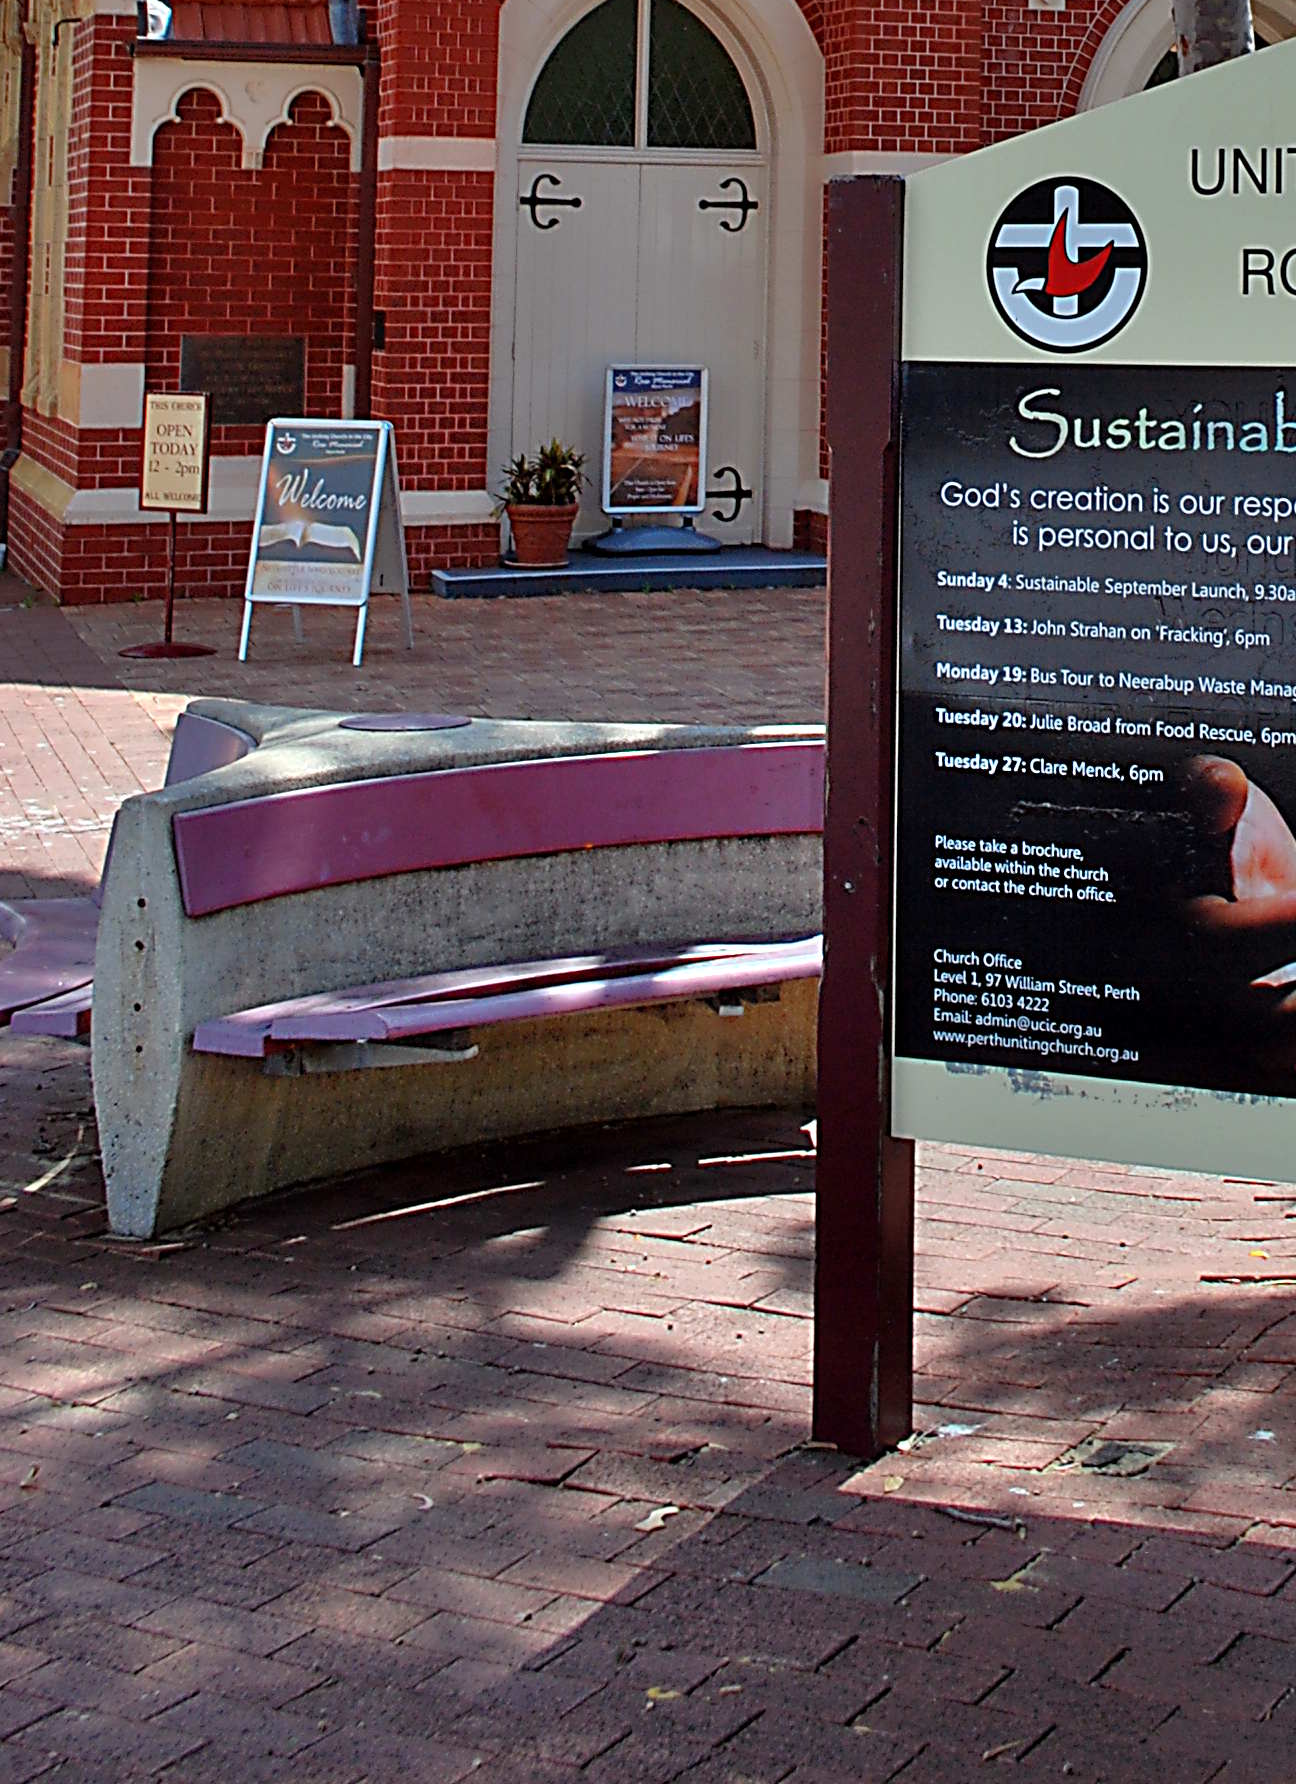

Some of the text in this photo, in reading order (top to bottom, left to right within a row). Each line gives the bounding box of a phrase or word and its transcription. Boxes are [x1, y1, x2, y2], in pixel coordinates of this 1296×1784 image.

[156, 423, 193, 438] OPEN
[150, 441, 199, 457] TODAY
[148, 459, 160, 473] 12
[175, 461, 200, 477] 2pm
[275, 468, 367, 510] Welcome
[941, 482, 1020, 508] God's
[1031, 486, 1142, 512] creation
[1154, 488, 1169, 513] is
[1180, 495, 1225, 514] our
[1013, 520, 1028, 545] is
[1039, 526, 1154, 551] personal
[1165, 526, 1192, 551] to
[1203, 534, 1236, 557] us,
[1247, 535, 1293, 555] our
[938, 571, 995, 592] Sunday
[998, 574, 1011, 589] 4:
[1016, 574, 1099, 593] Sustainable
[1105, 578, 1187, 598] September
[1192, 582, 1249, 601] Launch,
[937, 615, 1000, 636] Tuesday
[1004, 618, 1027, 634] 13:
[1031, 620, 1065, 635] John
[1071, 621, 1126, 639] Strahan
[1131, 628, 1150, 640] on
[1235, 629, 1270, 649] 6pm
[937, 663, 998, 685] Monday
[1003, 667, 1026, 682] 19:
[1031, 668, 1057, 684] Bus
[1061, 669, 1093, 685] Tour
[1099, 673, 1114, 687] to
[1119, 673, 1194, 695] Neerabup
[1198, 677, 1245, 695] Waste
[936, 708, 1296, 747] Tuesday 20: Julie Broad from Food Rescue, 6pm
[935, 752, 1163, 784] Tuesday 27: Clare Menck, 6pm
[935, 835, 1083, 861] Please take a brochure,
[935, 857, 1108, 881] available within the church
[935, 878, 1116, 902] or contact the church office.
[934, 949, 1022, 969] Church Office
[934, 969, 1139, 1000] Level 1, 97 William Street, Perth
[934, 988, 1049, 1011] Phone: 6103 4222
[934, 1008, 1101, 1038] Email: admin@ucic.org.au
[933, 1031, 1138, 1062] www.perthunitingchurch.org.au
